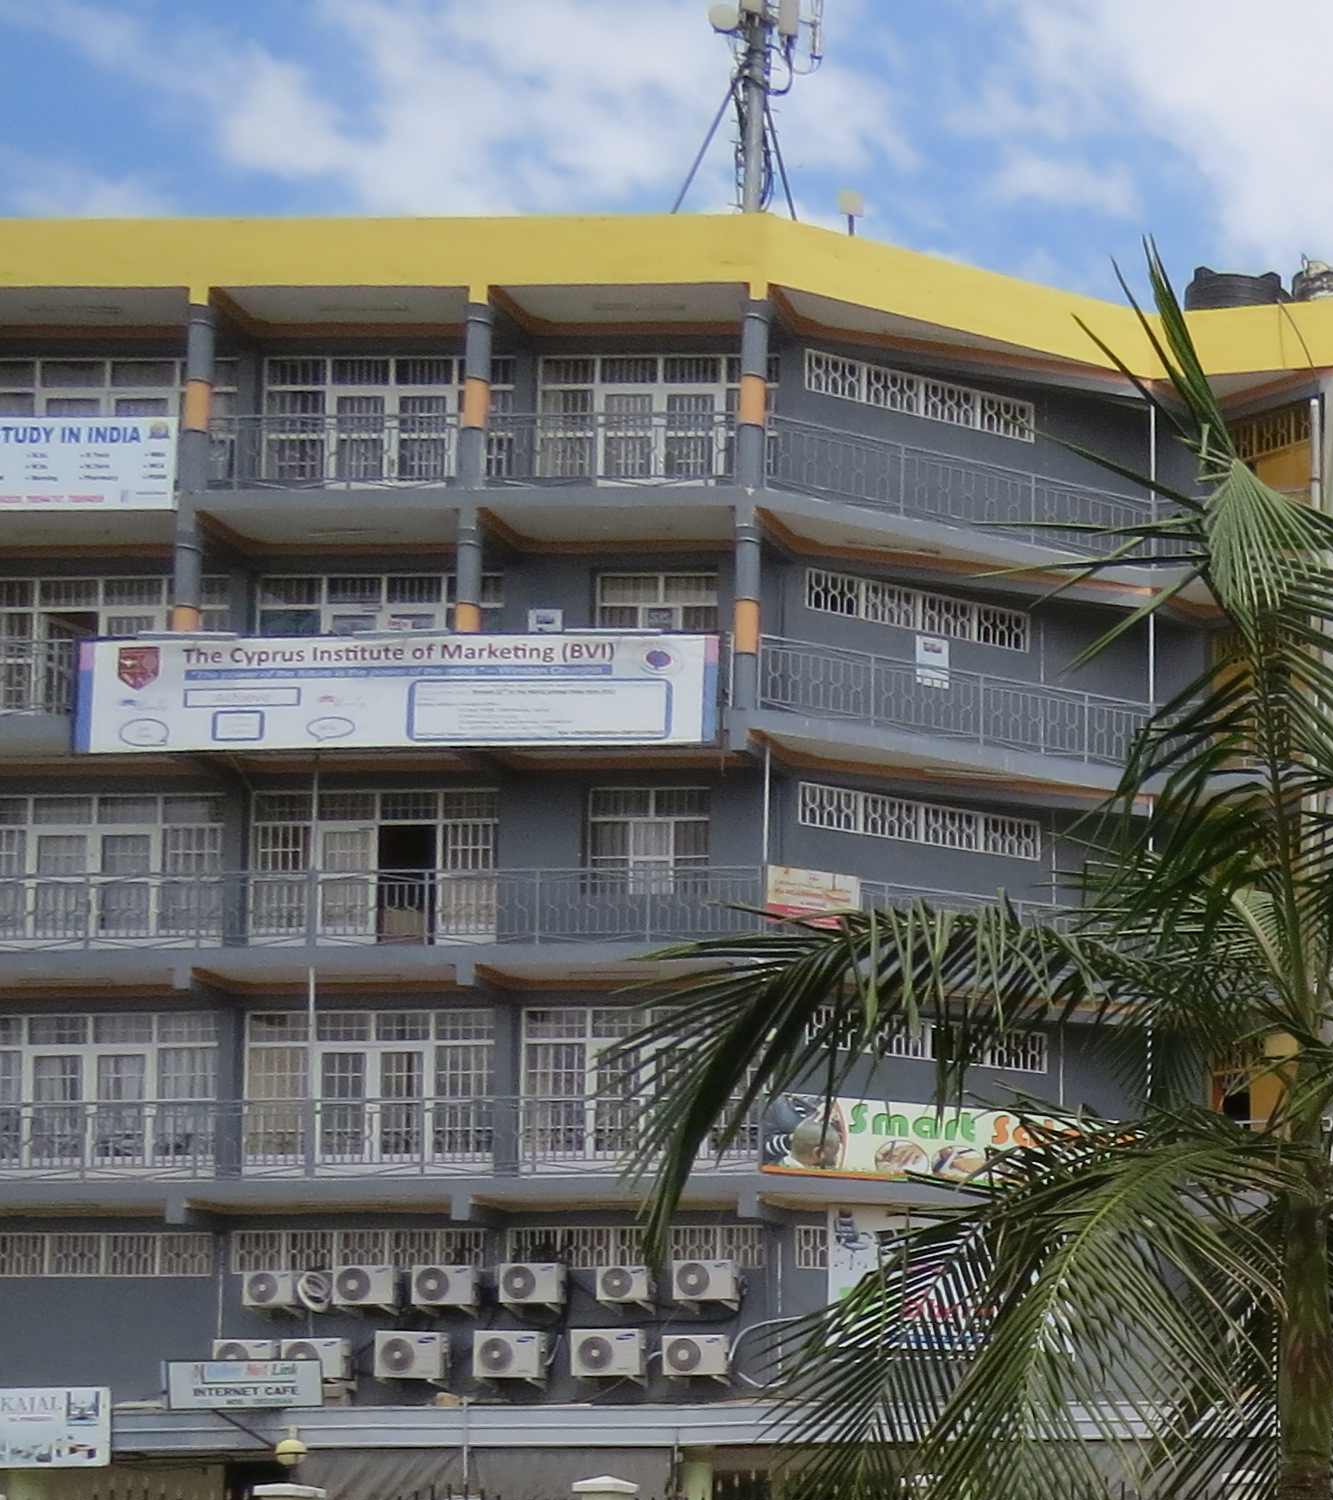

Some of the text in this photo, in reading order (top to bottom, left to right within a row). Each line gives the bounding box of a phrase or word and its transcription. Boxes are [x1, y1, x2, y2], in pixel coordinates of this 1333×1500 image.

[61, 426, 81, 443] IN
[88, 426, 141, 443] INDIA
[183, 642, 615, 667] The Cyprus Institute of Marketing (BVI)
[850, 1103, 976, 1142] Smart
[192, 1385, 299, 1397] INTERNET CAFE
